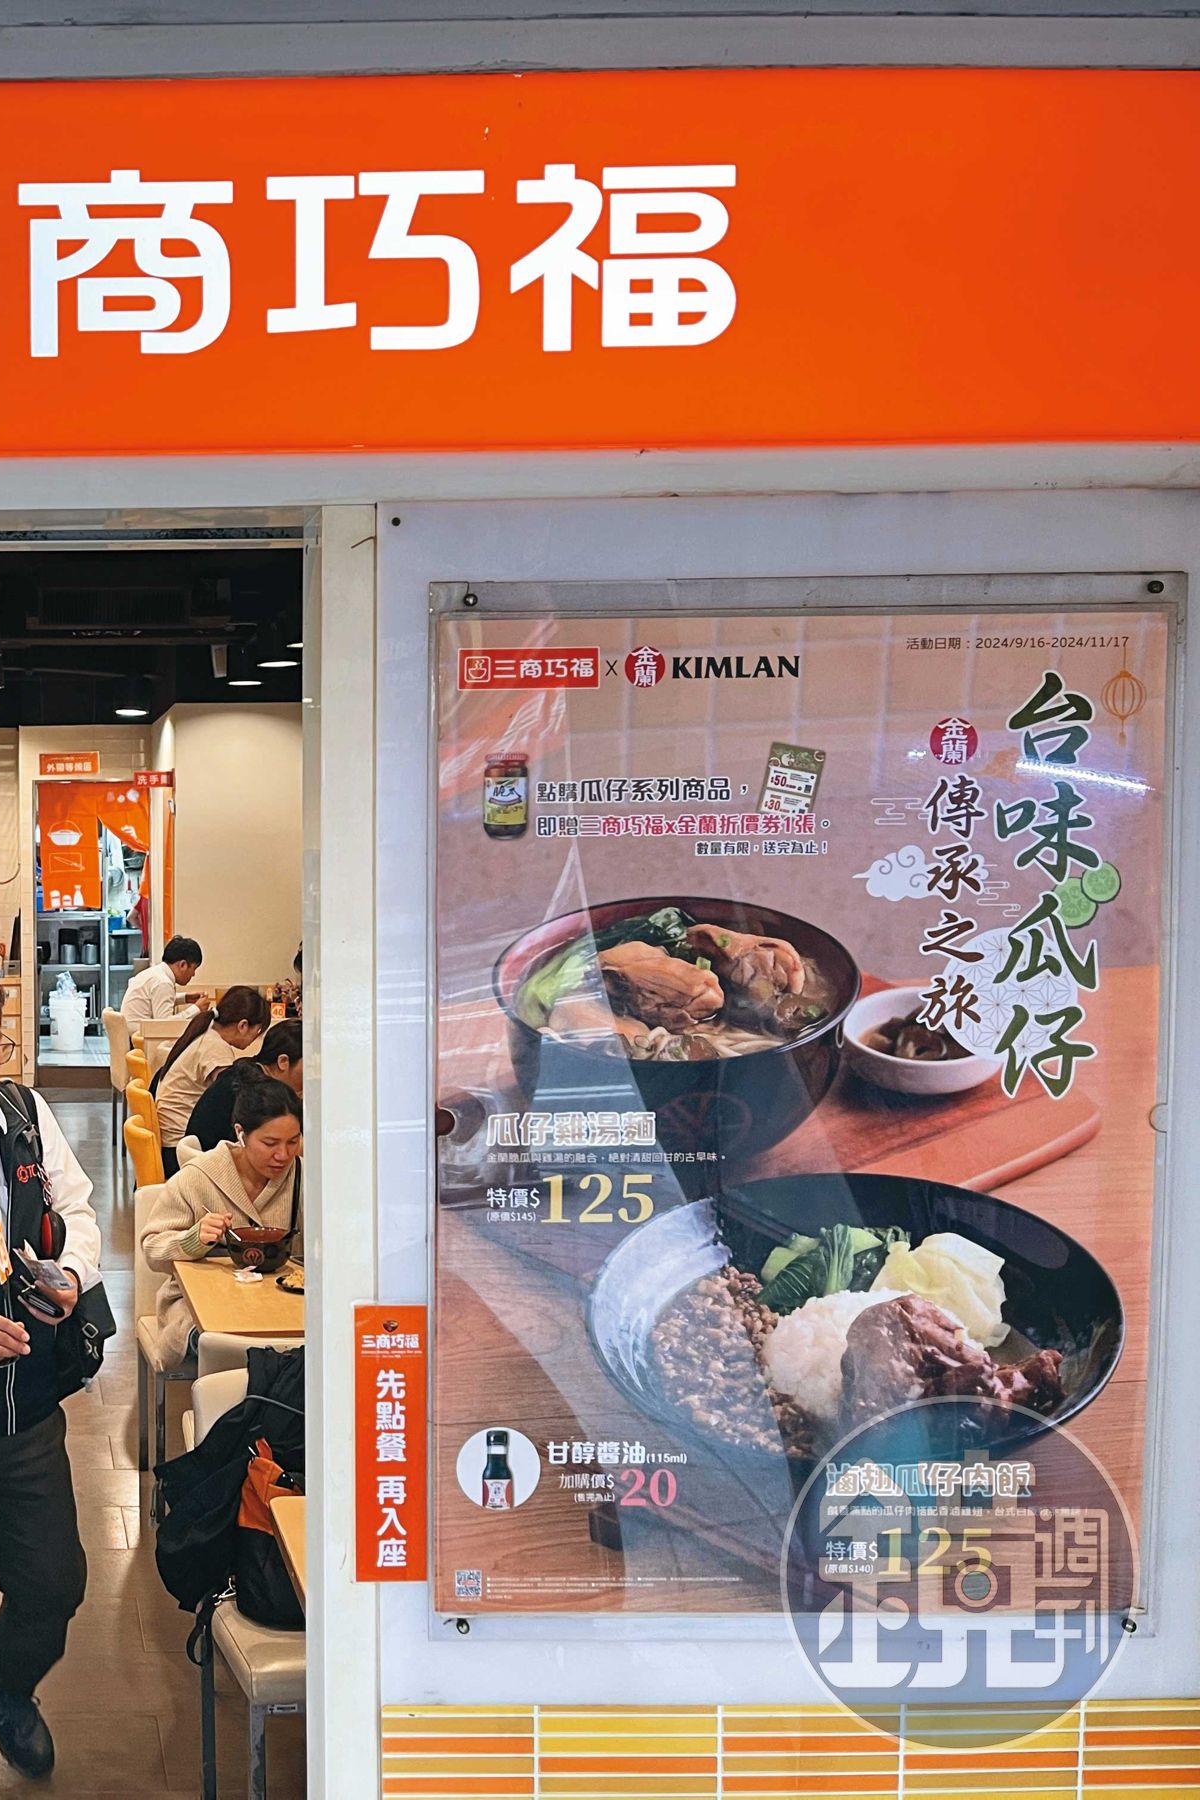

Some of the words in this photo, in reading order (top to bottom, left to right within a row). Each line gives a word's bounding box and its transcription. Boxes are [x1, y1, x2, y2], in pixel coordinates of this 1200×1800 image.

[493, 657, 595, 680] 三商巧福
[629, 646, 661, 688] 金蘭
[672, 655, 800, 680] KIMLAN
[939, 717, 969, 765] 金蘭
[919, 778, 986, 1031] 傳承之旅
[995, 672, 1100, 1097] 台味瓜仔
[486, 1111, 657, 1147] 瓜仔雞湯麵
[541, 1173, 655, 1224] 125
[361, 1333, 420, 1349] 三商巧福
[619, 1468, 678, 1508] 20
[825, 1462, 1032, 1498] 滷翅瓜仔肉飯
[878, 1526, 993, 1576] 125
